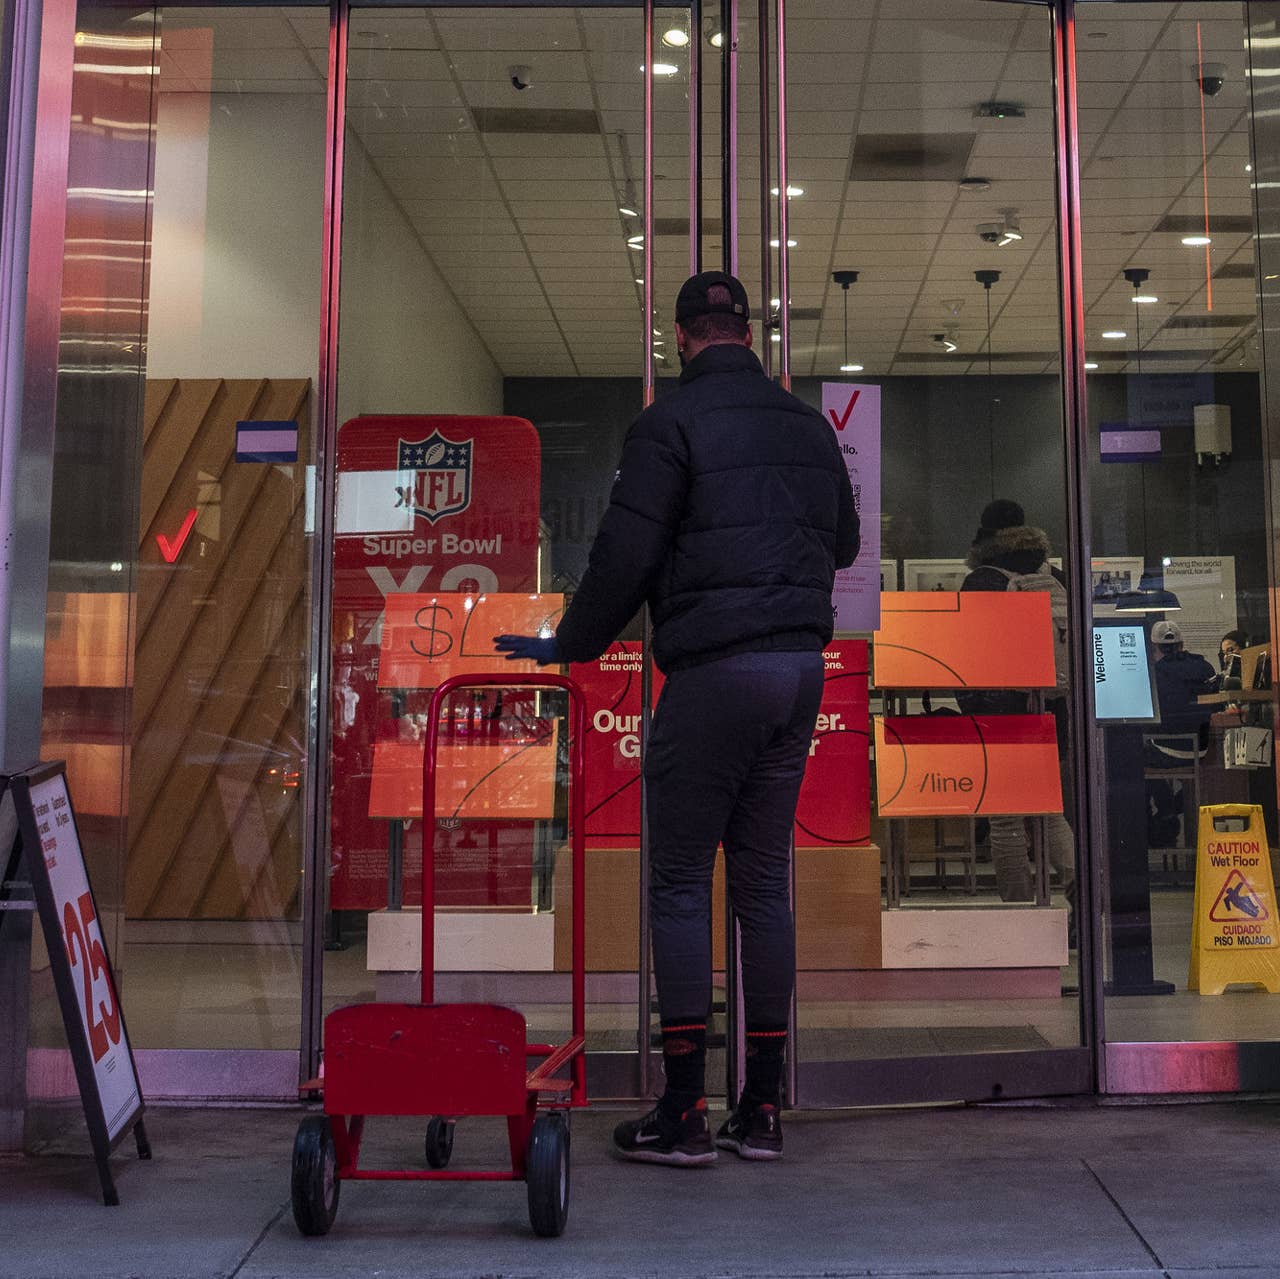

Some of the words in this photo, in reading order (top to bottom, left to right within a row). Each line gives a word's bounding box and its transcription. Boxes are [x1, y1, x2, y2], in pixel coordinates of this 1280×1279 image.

[363, 534, 437, 558] Super
[442, 534, 502, 556] Bowl
[1094, 633, 1106, 683] Welcome
[600, 662, 620, 671] time
[593, 710, 641, 733] Our
[920, 773, 974, 793] /line
[1207, 842, 1260, 855] CAUTION
[1211, 856, 1231, 867] Wet
[1233, 856, 1260, 867] Floor
[1223, 926, 1261, 935] CUIDADO
[1214, 936, 1234, 946] PISO
[1237, 936, 1271, 945] MOJADO
[61, 891, 121, 1064] 25
